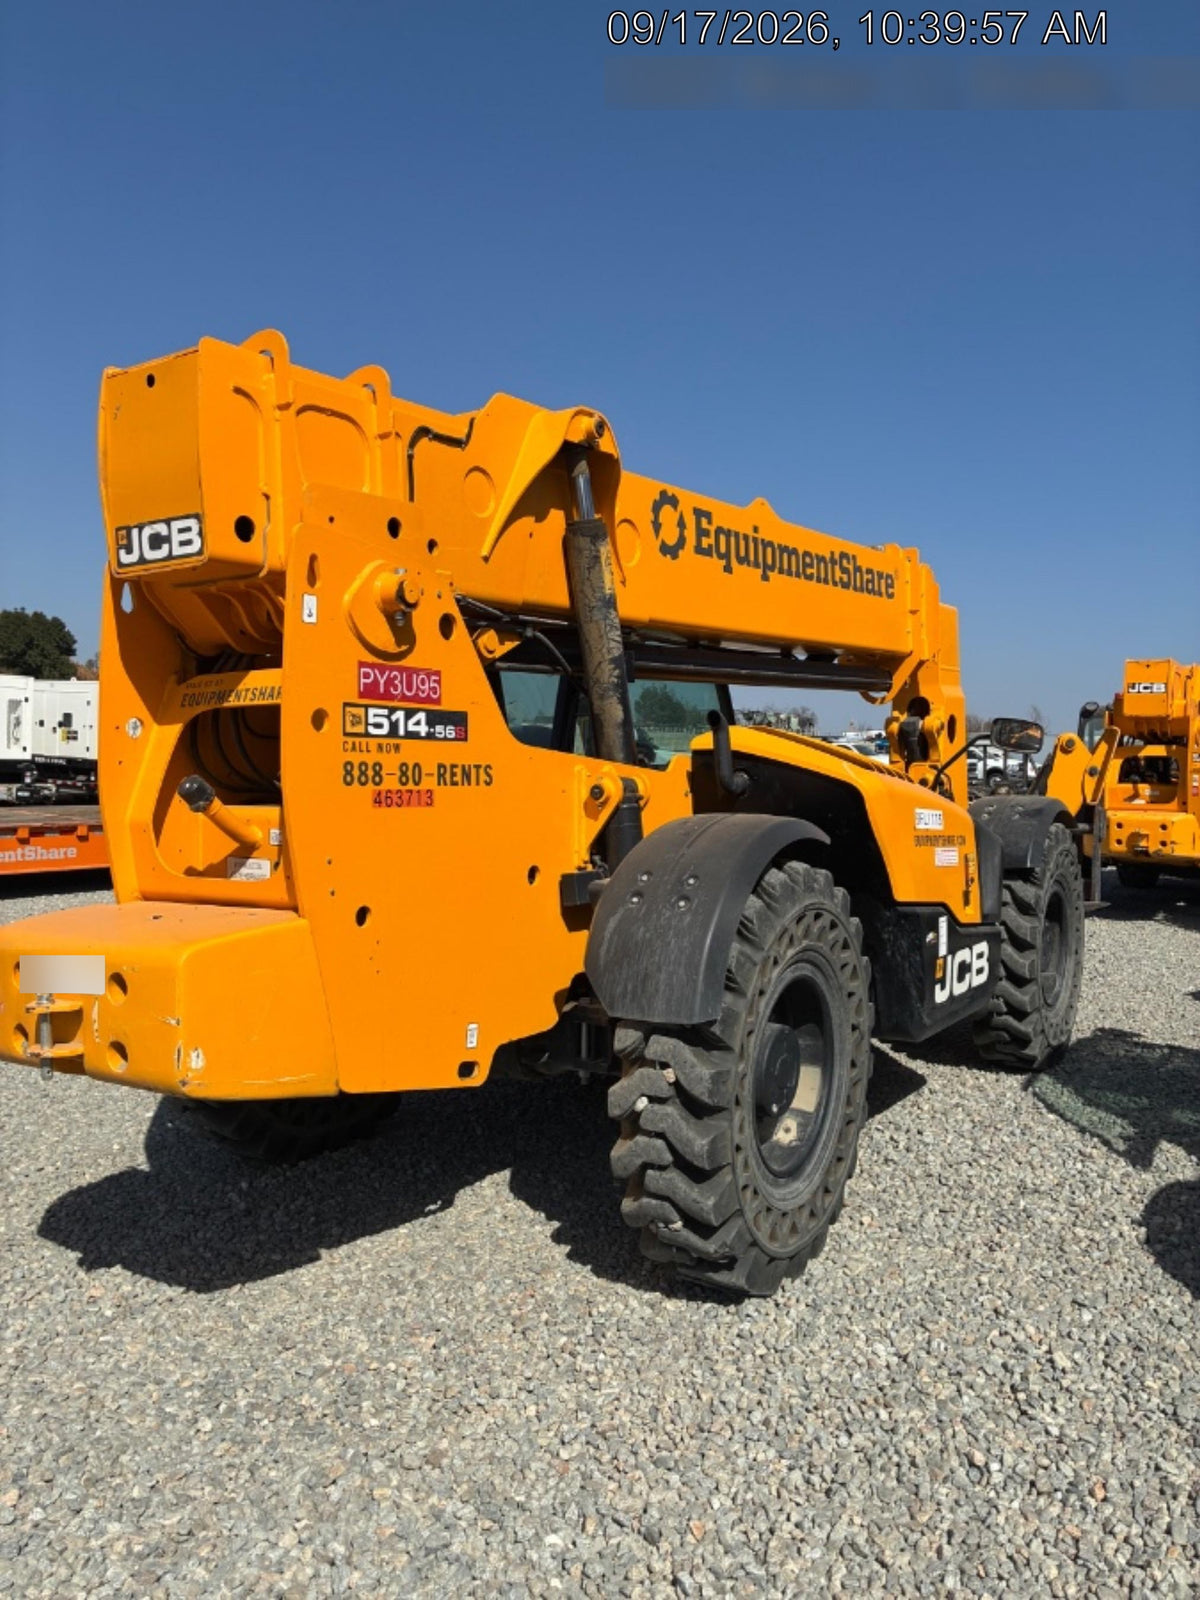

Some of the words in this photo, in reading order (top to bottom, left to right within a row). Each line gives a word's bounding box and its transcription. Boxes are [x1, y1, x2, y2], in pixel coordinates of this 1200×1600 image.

[118, 518, 202, 564] JCB
[693, 506, 896, 600] EquipmentShare
[360, 667, 440, 699] PY3U95
[1128, 683, 1166, 693] JCB
[342, 741, 372, 753] CALL
[376, 743, 402, 754] NOW
[342, 760, 494, 787] 888-80-RENTS
[373, 789, 434, 808] 463713
[935, 941, 990, 1004] JCB
